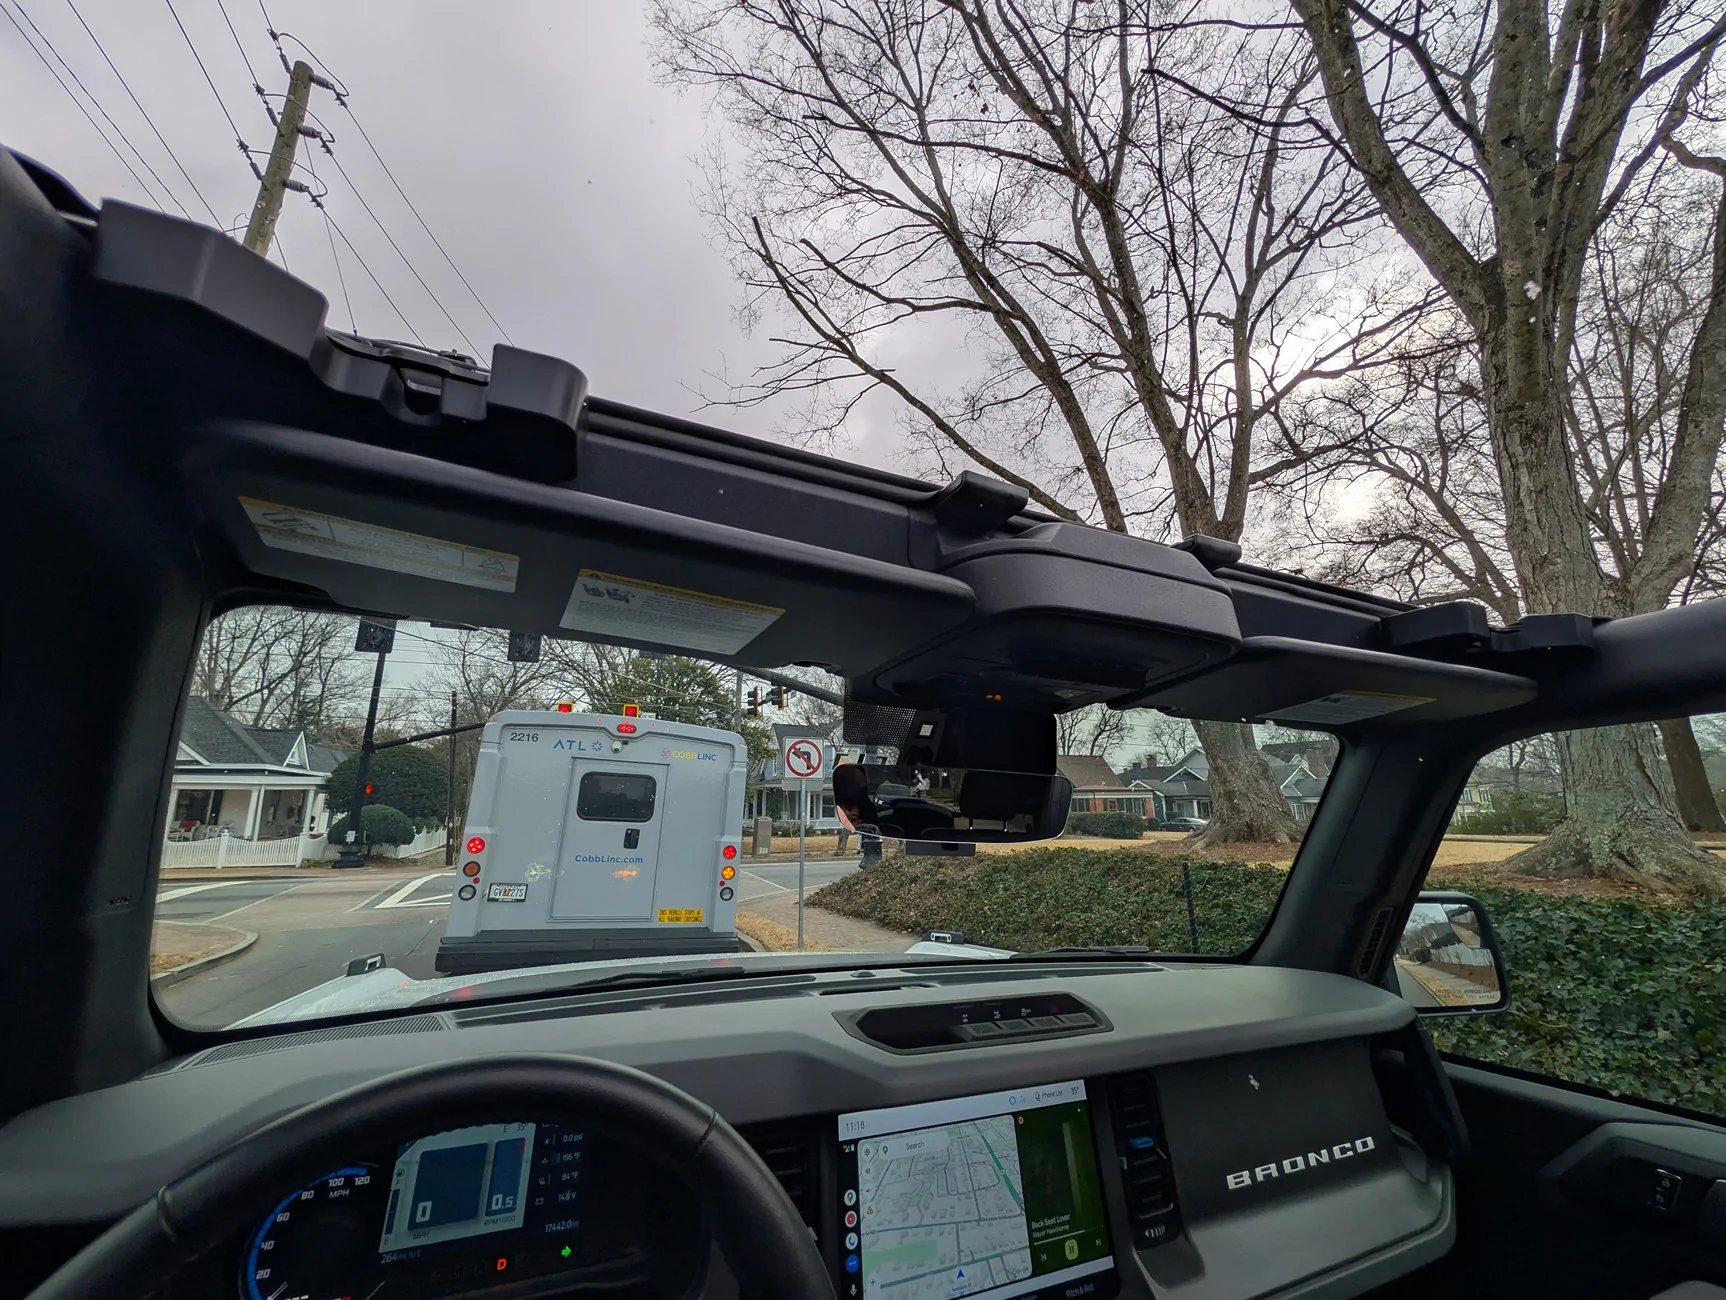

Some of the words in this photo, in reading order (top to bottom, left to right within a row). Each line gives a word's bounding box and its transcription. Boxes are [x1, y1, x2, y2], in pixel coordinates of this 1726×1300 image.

[510, 732, 539, 742] 2216
[553, 739, 586, 751] ATL
[574, 855, 644, 864] CobbLinc.com
[845, 1120, 866, 1132] 11:18
[906, 1141, 925, 1151] Search
[1226, 1136, 1375, 1190] BRONCO
[328, 1177, 345, 1187] 100
[354, 1176, 371, 1186] 120
[301, 1190, 314, 1200] 80
[329, 1189, 350, 1199] MPH
[491, 1194, 514, 1210] 0.5
[276, 1212, 290, 1222] 60
[415, 1201, 432, 1223] 0
[260, 1240, 275, 1251] 40
[497, 1257, 507, 1271] D
[256, 1268, 271, 1280] 20
